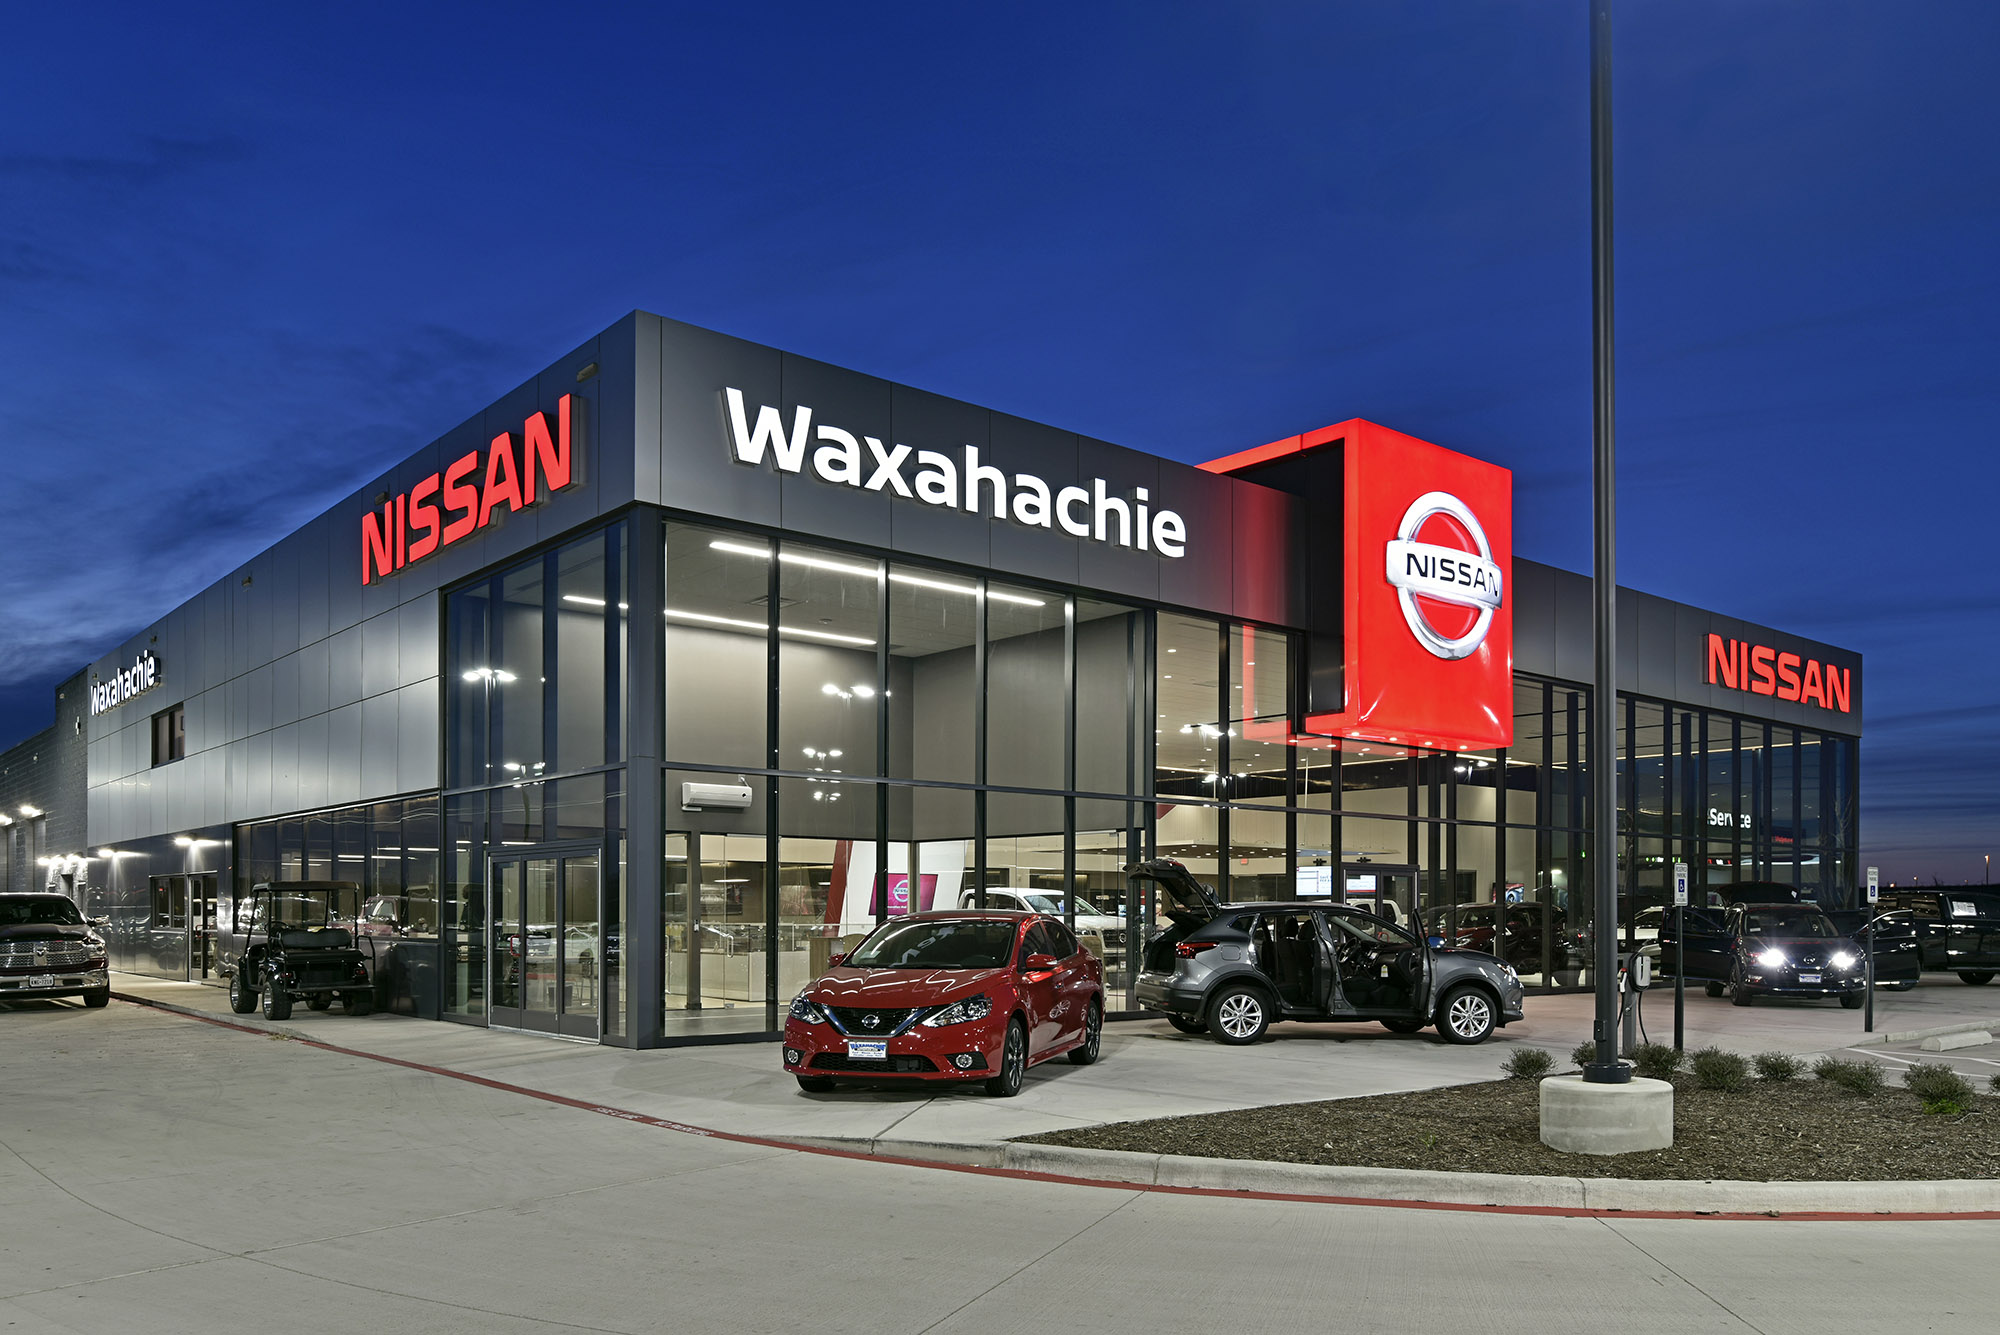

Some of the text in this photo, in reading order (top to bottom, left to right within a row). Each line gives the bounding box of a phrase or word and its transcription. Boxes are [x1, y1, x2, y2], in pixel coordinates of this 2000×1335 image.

[362, 393, 572, 586] NISSAN
[724, 386, 1186, 558] Waxahachie
[1406, 552, 1499, 597] NISSAN
[90, 649, 155, 716] Waxahachie
[1708, 633, 1851, 713] NISSAN
[1709, 808, 1751, 829] Servce
